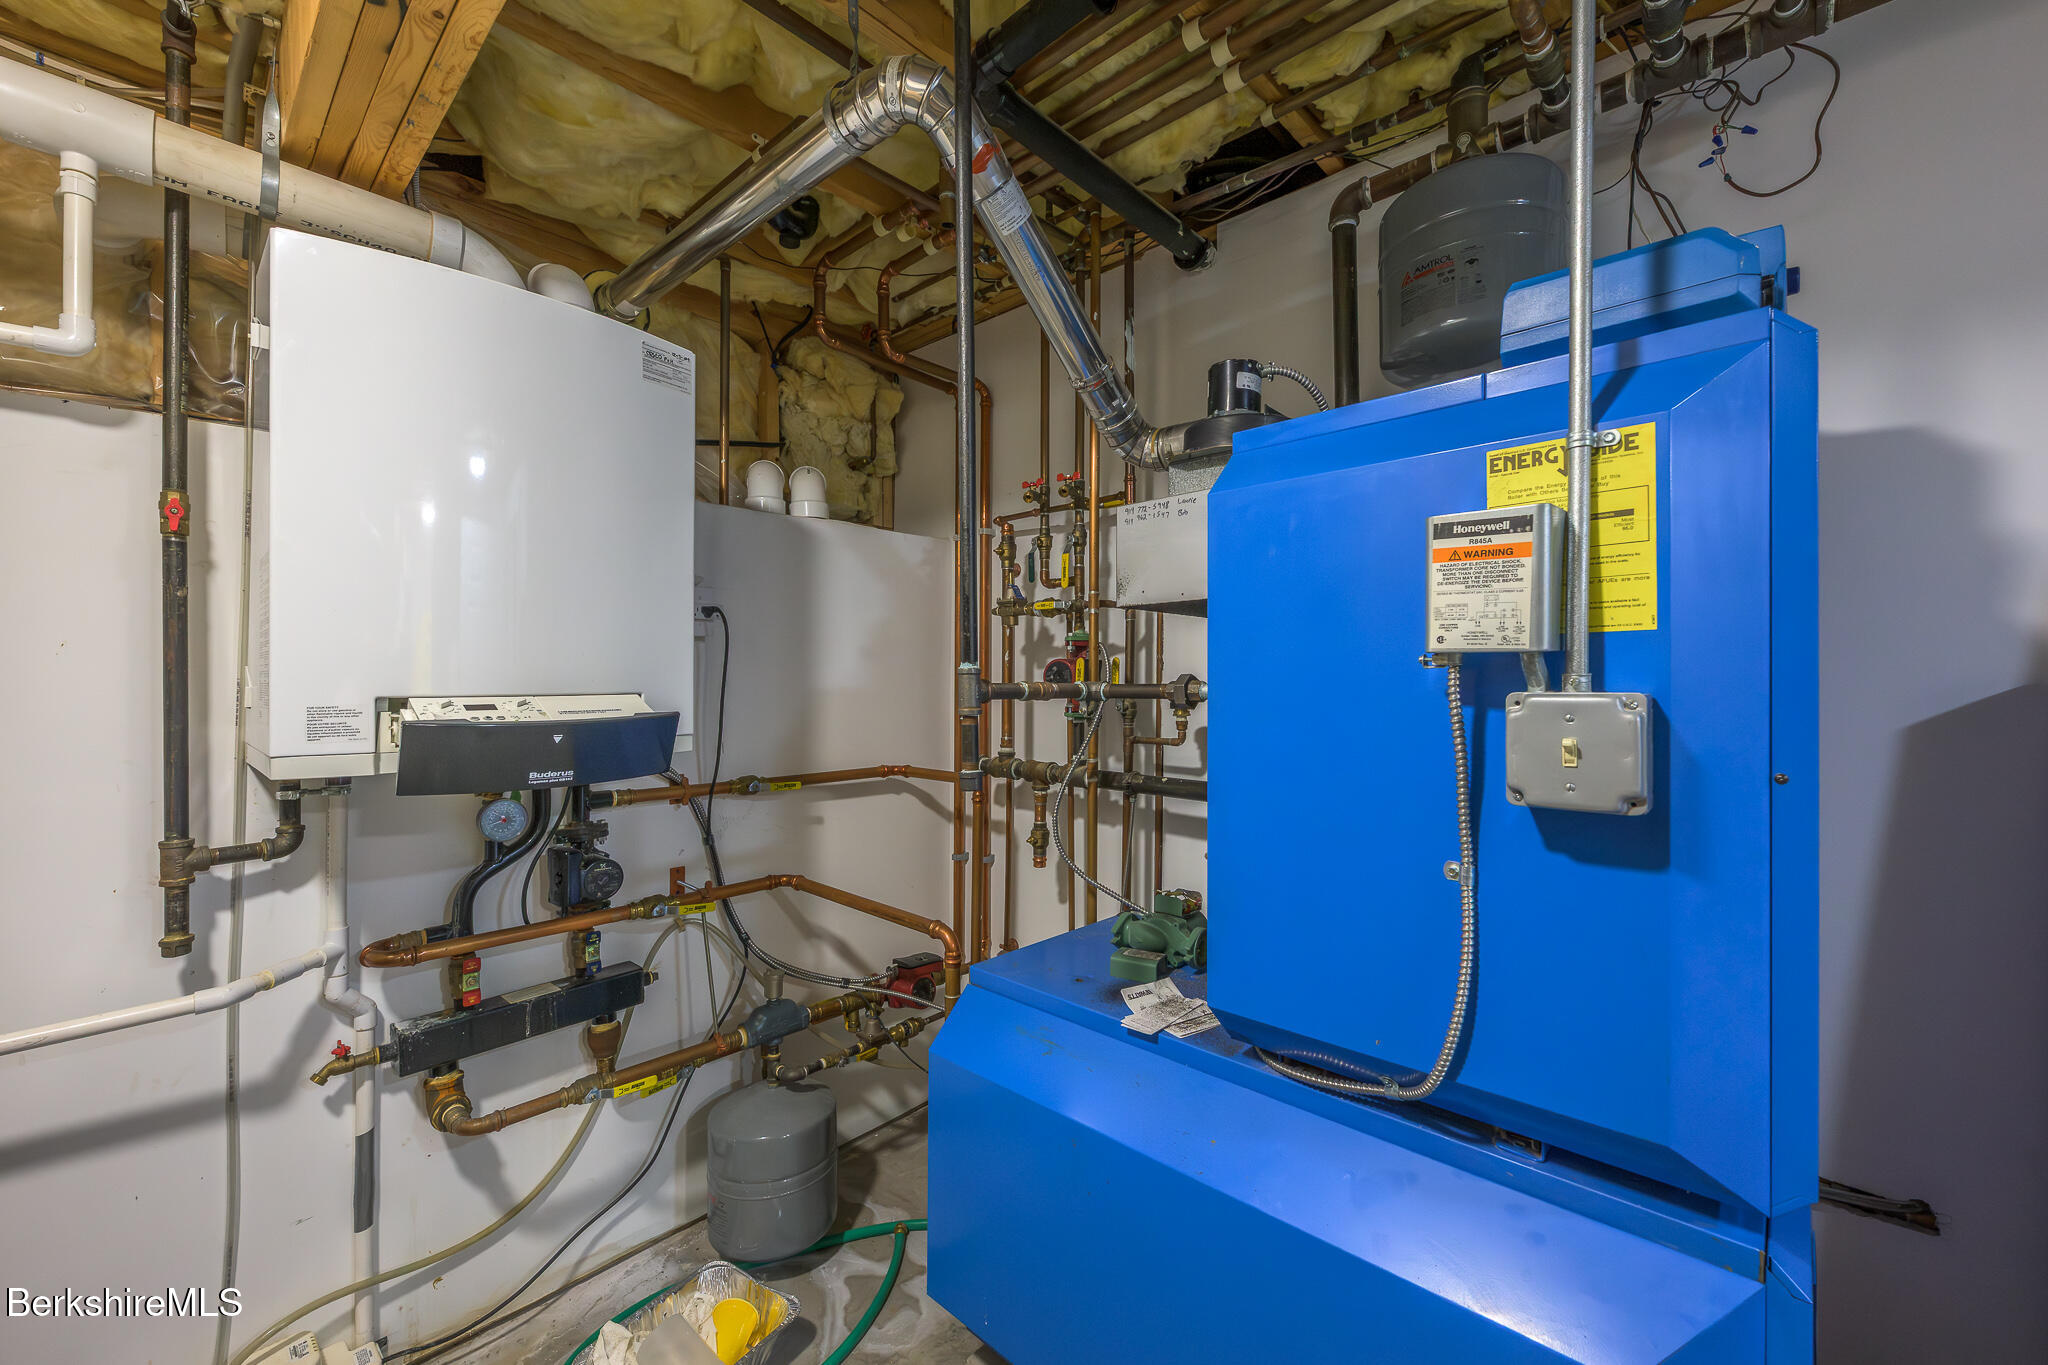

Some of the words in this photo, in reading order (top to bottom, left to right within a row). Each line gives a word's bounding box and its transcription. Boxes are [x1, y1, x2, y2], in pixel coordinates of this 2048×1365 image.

[1413, 254, 1454, 275] AMTROL
[1452, 520, 1510, 534] Honeywell
[1468, 537, 1493, 545] R845A
[1463, 547, 1514, 559] WARNING
[529, 770, 574, 779] Buderus
